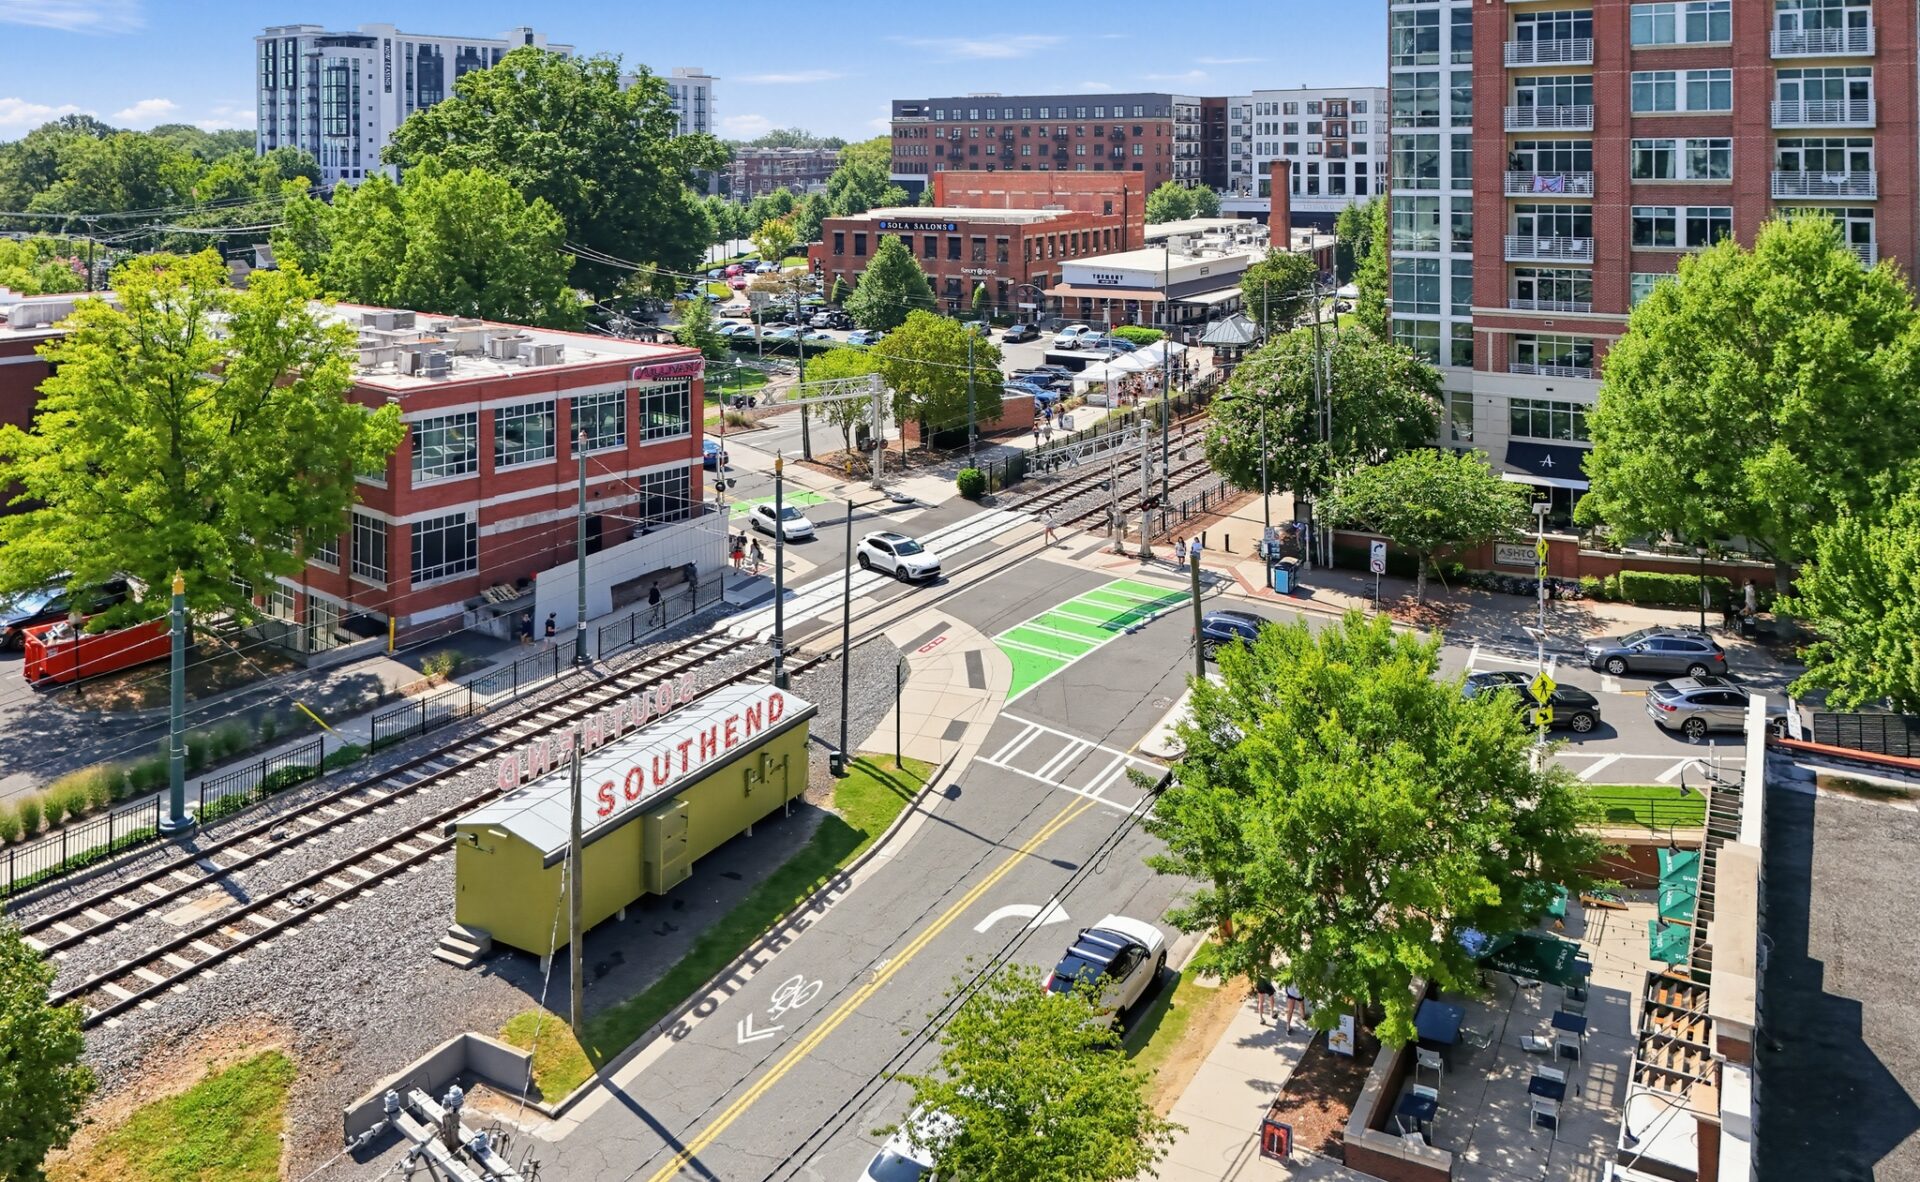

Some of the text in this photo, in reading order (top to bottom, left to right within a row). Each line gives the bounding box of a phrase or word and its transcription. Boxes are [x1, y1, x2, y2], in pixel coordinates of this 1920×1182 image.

[887, 222, 947, 231] SOLA SALONS
[1539, 454, 1557, 467] A
[1499, 547, 1536, 558] ASHTO
[597, 692, 785, 817] SOUTHEND
